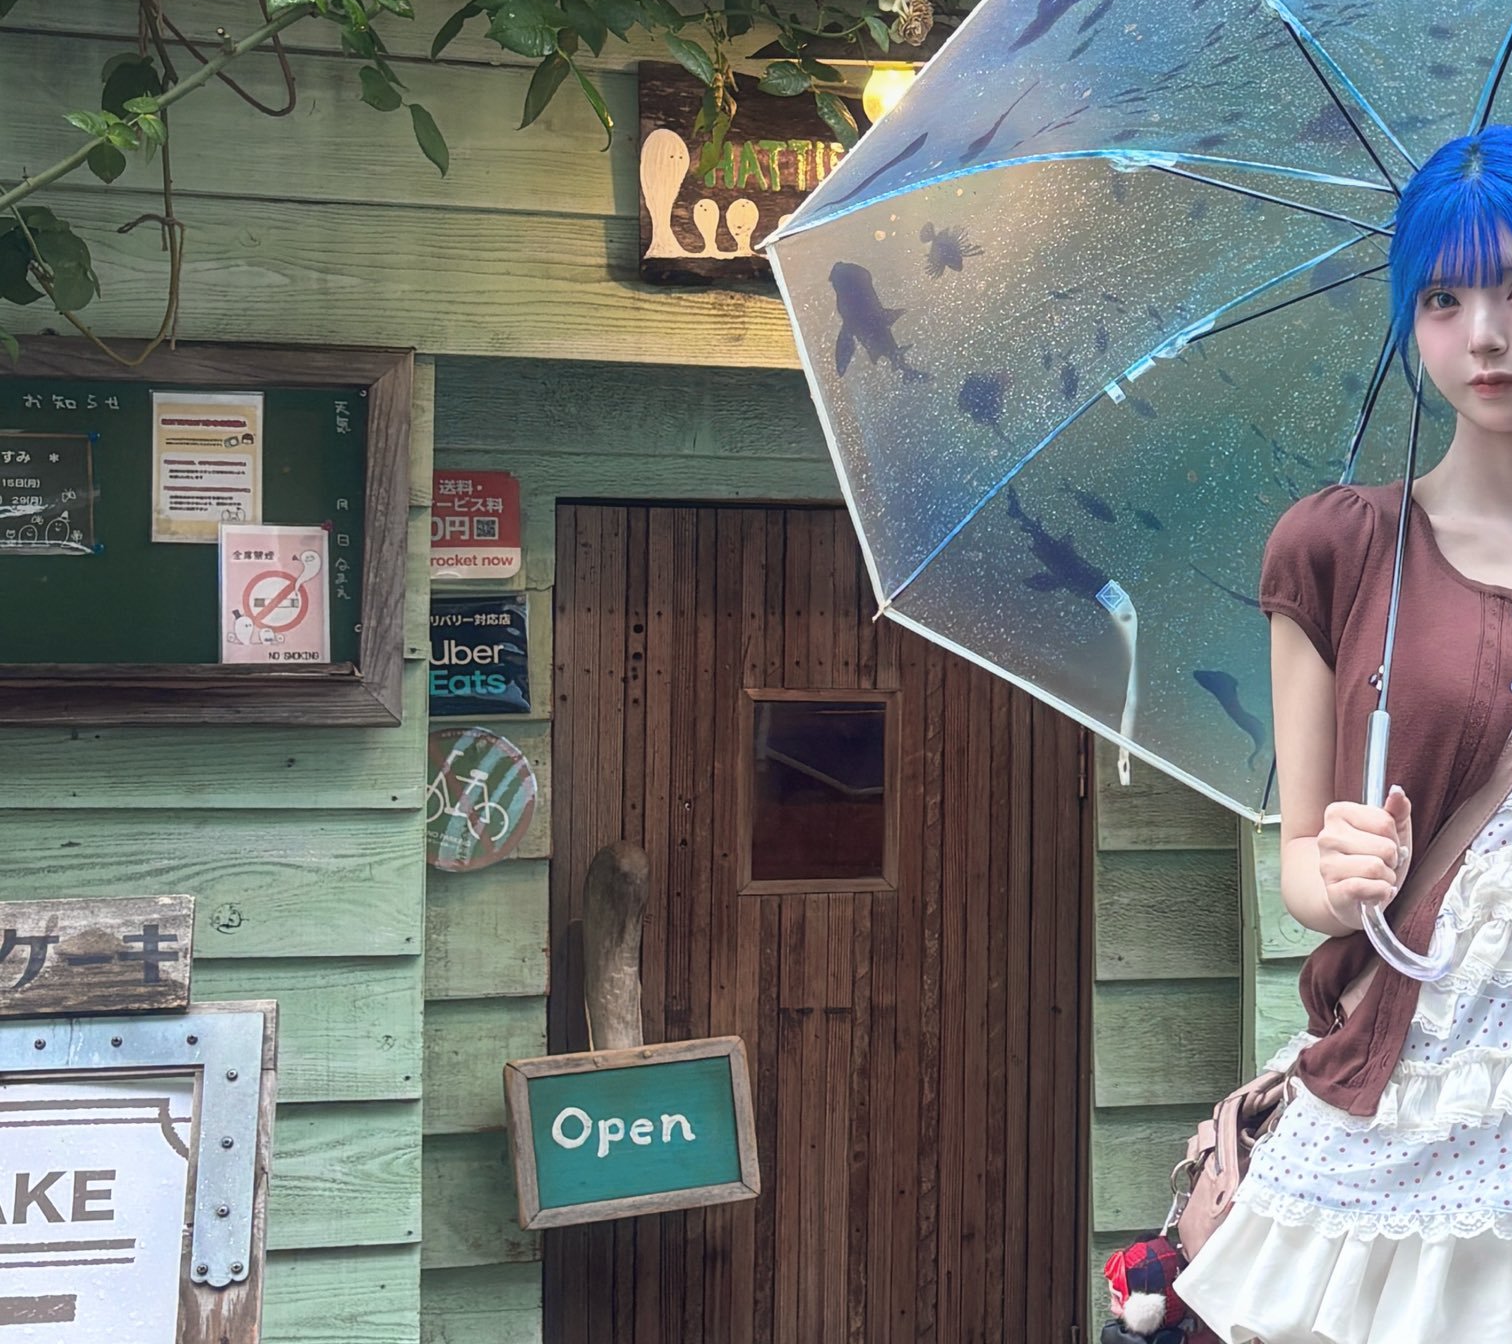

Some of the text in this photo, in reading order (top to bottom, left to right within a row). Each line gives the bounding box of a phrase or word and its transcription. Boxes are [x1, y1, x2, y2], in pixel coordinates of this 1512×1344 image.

[23, 394, 120, 409] お知らせ
[432, 497, 504, 513] ービス料
[232, 550, 275, 561] 全席禁煙
[430, 554, 514, 567] rocket now
[268, 651, 320, 661] NO SMOKING
[429, 639, 505, 666] Uber
[429, 668, 507, 696] Eats
[0, 923, 180, 989] ケーキ
[551, 1106, 696, 1158] Open
[0, 1169, 117, 1225] KE
